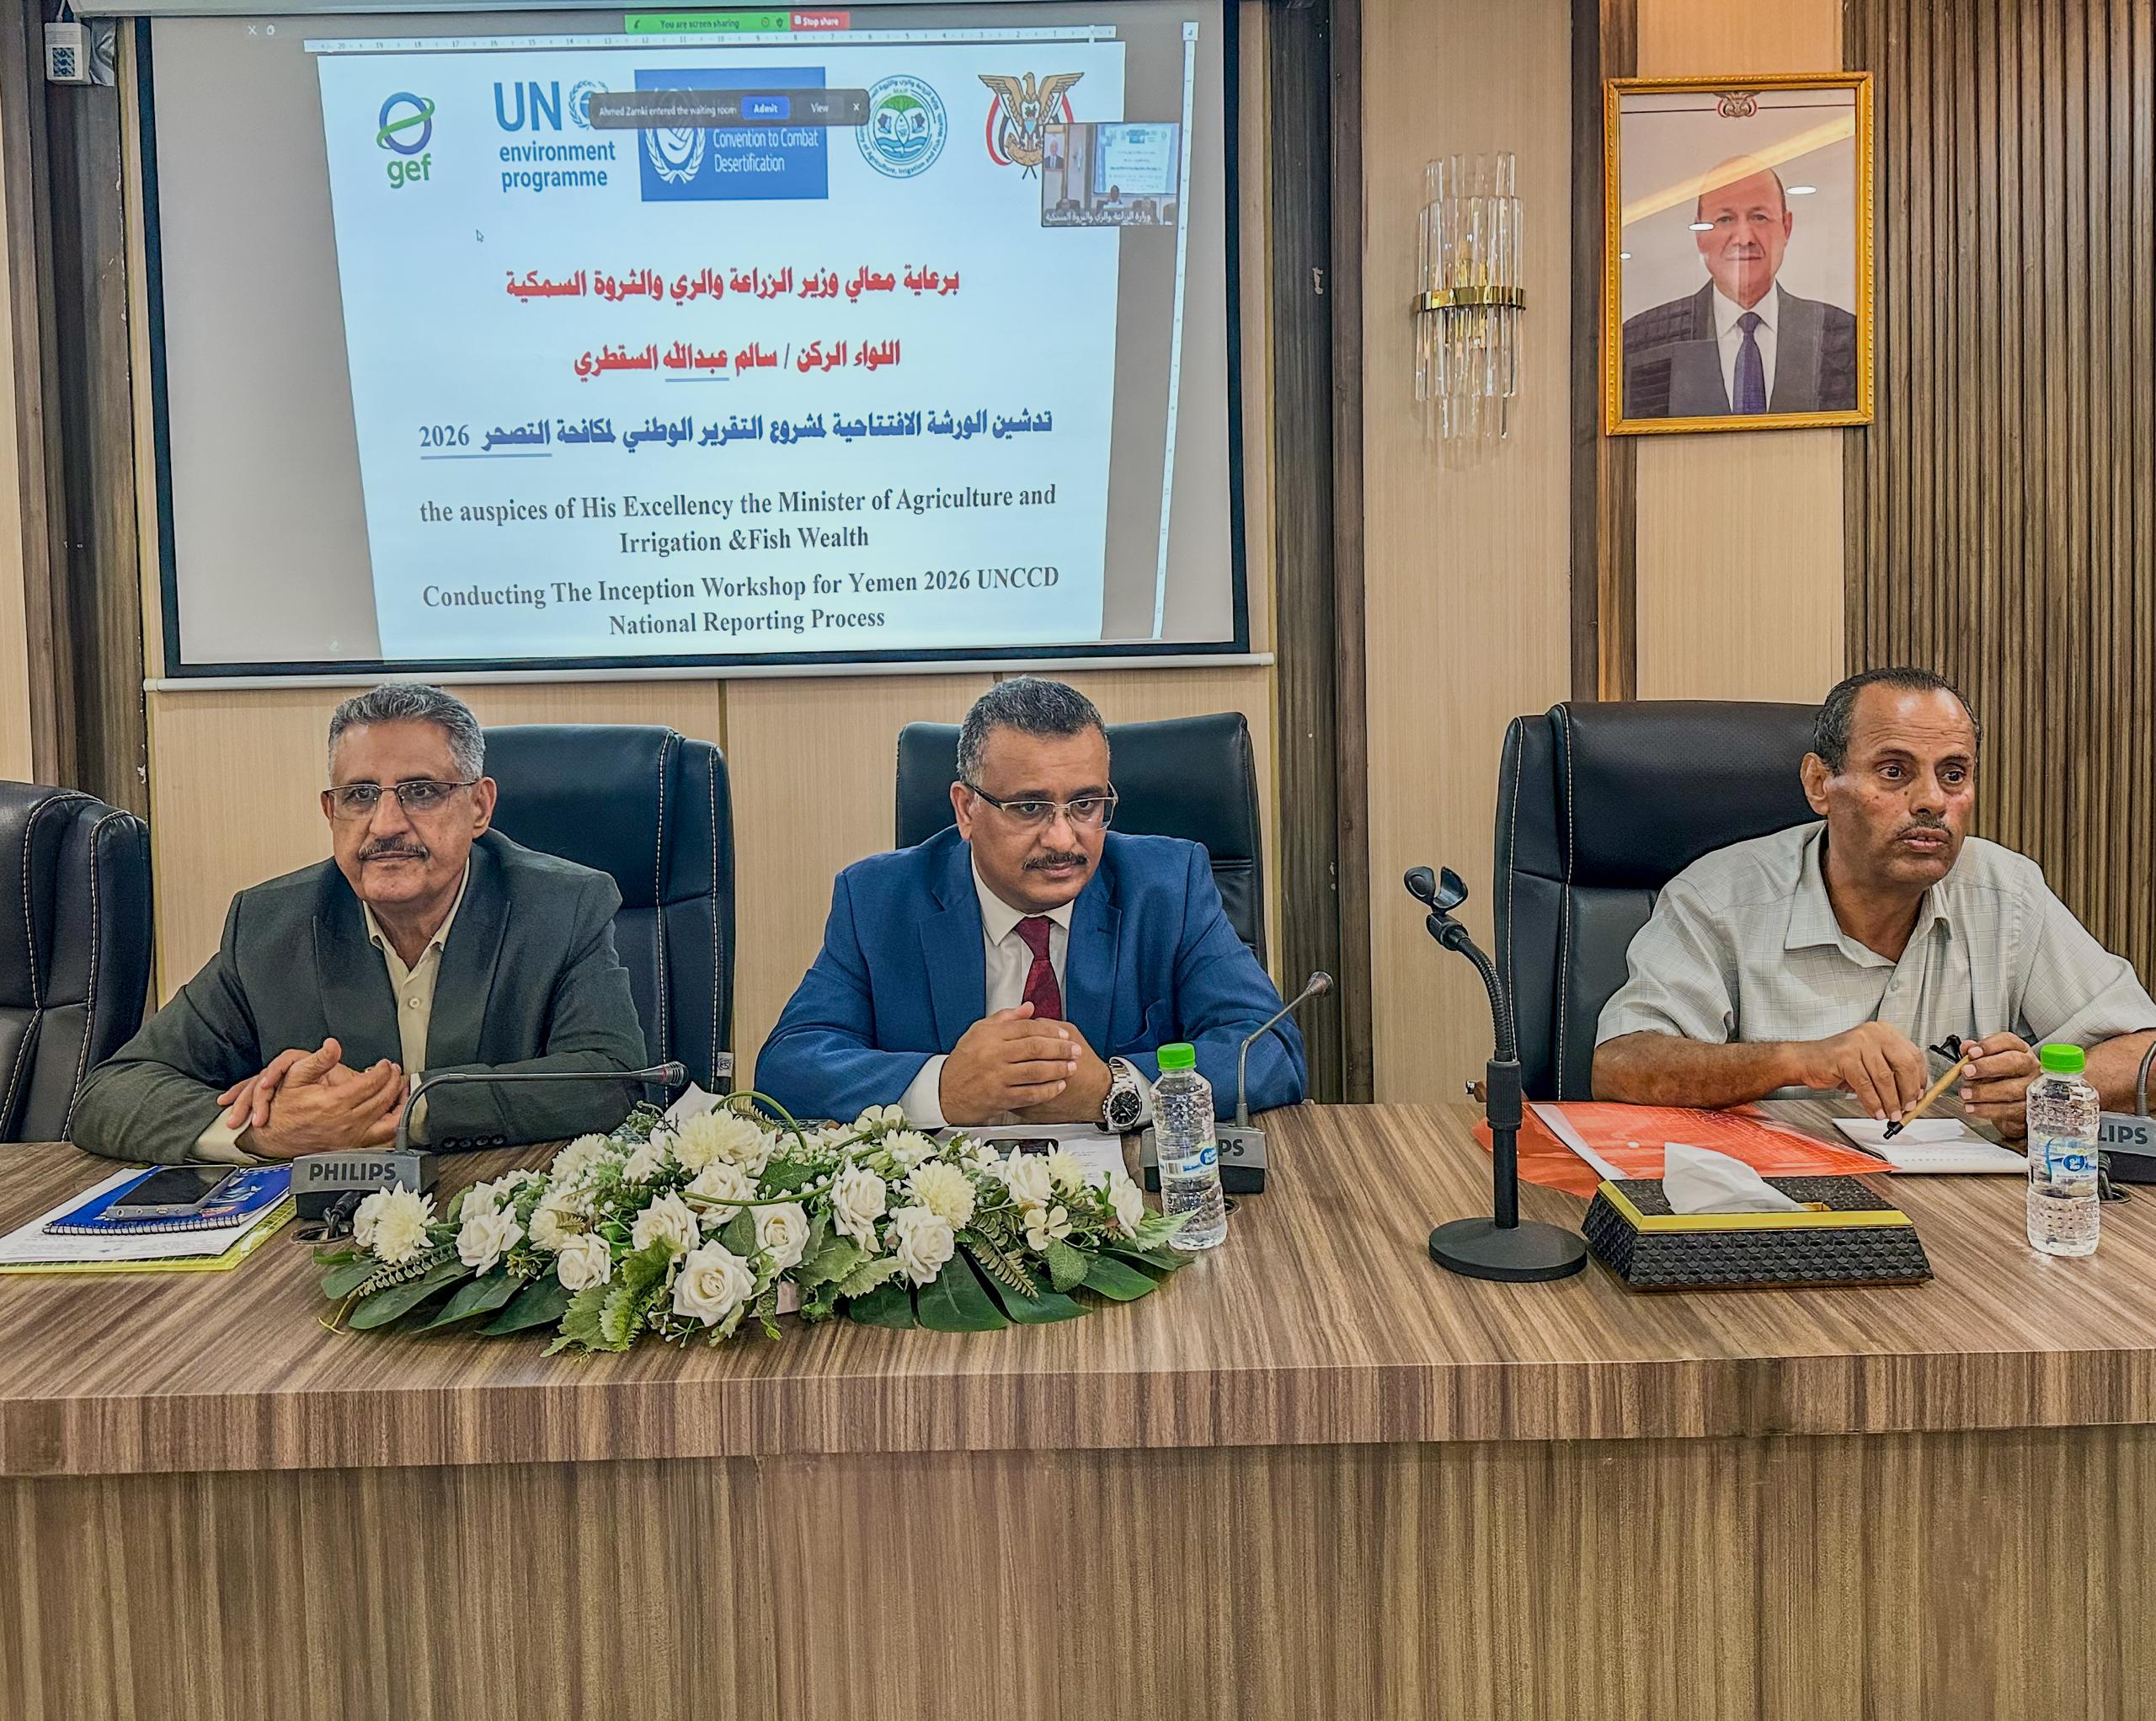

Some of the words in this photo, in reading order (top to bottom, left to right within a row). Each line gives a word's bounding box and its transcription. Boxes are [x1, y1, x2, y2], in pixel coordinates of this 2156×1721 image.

[659, 19, 675, 29] You
[712, 19, 739, 29] sharing
[803, 17, 819, 28] Stop
[820, 17, 839, 26] share
[494, 80, 563, 132] UN
[599, 106, 625, 116] Ahmed
[648, 105, 676, 116] entered
[676, 105, 689, 115] the
[689, 104, 717, 118] waiting
[717, 107, 737, 115] room
[754, 104, 778, 113] Admit
[810, 102, 830, 113] View
[499, 140, 616, 163] environment
[713, 129, 766, 147] Convention
[767, 130, 779, 147] to
[781, 128, 819, 147] Combat
[387, 153, 432, 190] gef
[714, 152, 785, 173] Desertification
[501, 170, 608, 194] programme
[505, 269, 588, 303] السمكية
[594, 268, 664, 302] والثروة
[670, 267, 724, 307] والري
[729, 265, 793, 300] الزراعة
[797, 266, 840, 299] وزير
[845, 265, 897, 304] معالي
[903, 264, 960, 297] برعاية
[574, 343, 659, 383] السقطري
[663, 340, 728, 375] عبدالله
[734, 341, 778, 377] سالم
[783, 342, 791, 370] /
[797, 339, 847, 373] الركن
[852, 339, 901, 370] اللواء
[419, 424, 470, 447] 2026
[480, 419, 551, 452] التصحر
[556, 417, 616, 444] لمكافحة
[622, 415, 694, 454] الوطني
[696, 414, 764, 447] التقرير
[769, 412, 828, 446] لمشروع
[832, 410, 922, 443] الافتتاحية
[926, 408, 988, 441] الورشة
[991, 407, 1053, 441] تدشين
[419, 500, 453, 522] the
[460, 498, 548, 526] auspices
[554, 496, 577, 520] of
[580, 495, 616, 519] His
[622, 494, 734, 521] Excellency
[739, 492, 772, 515] the
[777, 489, 866, 513] Minister
[871, 488, 894, 510] of
[895, 486, 1013, 516] Agriculture
[1019, 484, 1056, 506] and
[619, 530, 722, 559] Irrigation
[728, 527, 792, 551] &Fish
[797, 526, 869, 548] Wealth
[423, 583, 547, 610] Conducting
[550, 581, 592, 603] The
[597, 577, 695, 606] Inception
[700, 575, 806, 601] Workshop
[812, 573, 843, 594] for
[848, 572, 918, 593] Yemen
[924, 569, 971, 591] 2026
[976, 566, 1059, 590] UNCCD
[608, 612, 697, 635] National
[702, 609, 805, 637] Reporting
[811, 608, 885, 628] Process
[2098, 1124, 2148, 1145] LIPS
[309, 1162, 397, 1181] PHILIPS
